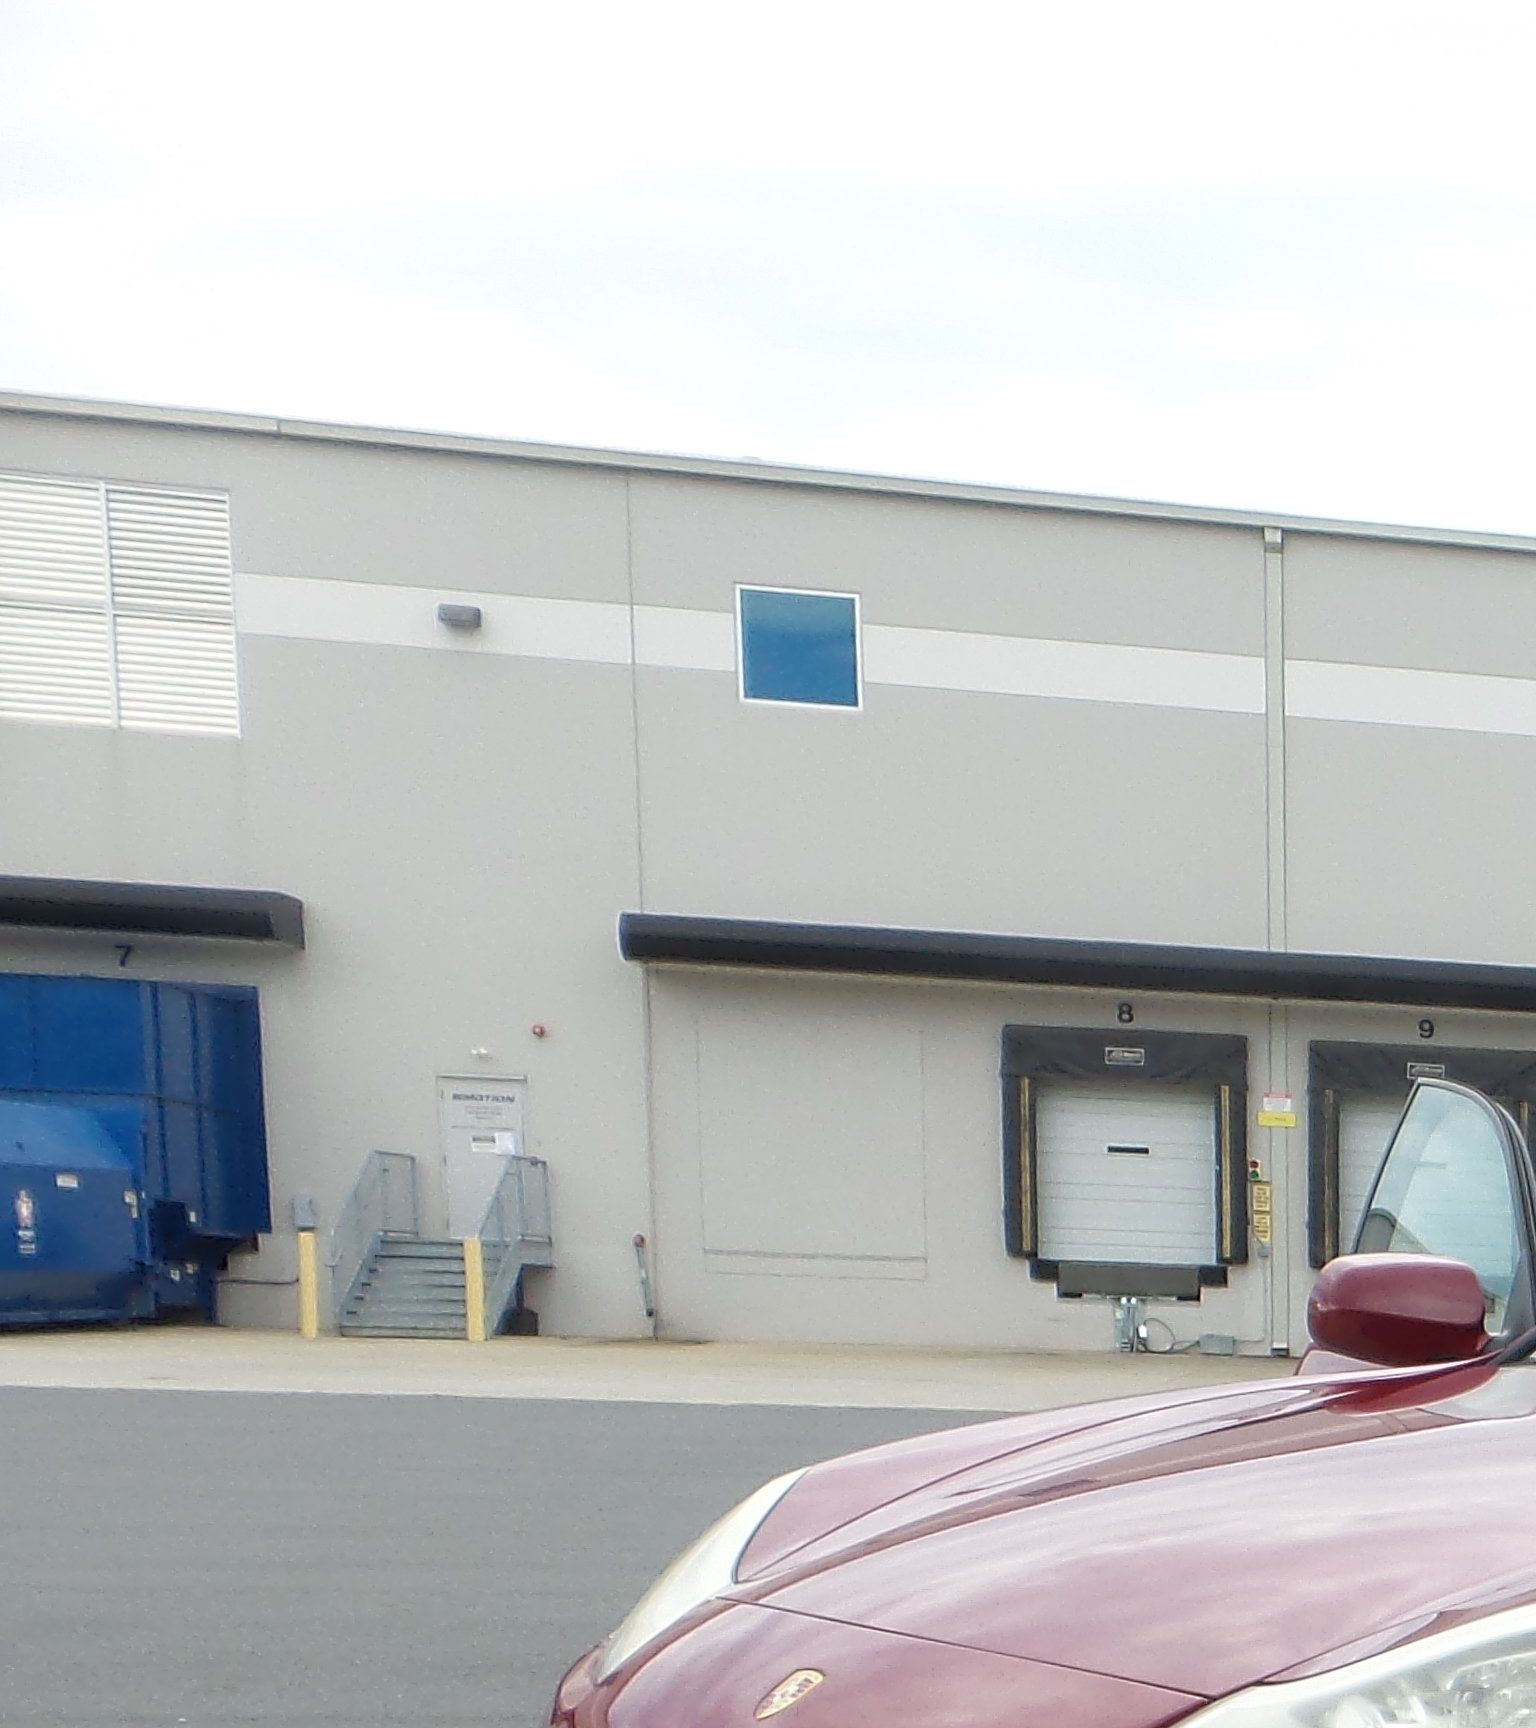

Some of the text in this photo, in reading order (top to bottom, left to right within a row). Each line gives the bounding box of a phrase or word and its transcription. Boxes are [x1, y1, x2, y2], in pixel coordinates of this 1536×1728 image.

[114, 944, 132, 968] 7
[1117, 1003, 1134, 1024] 8
[1418, 1019, 1435, 1039] 9
